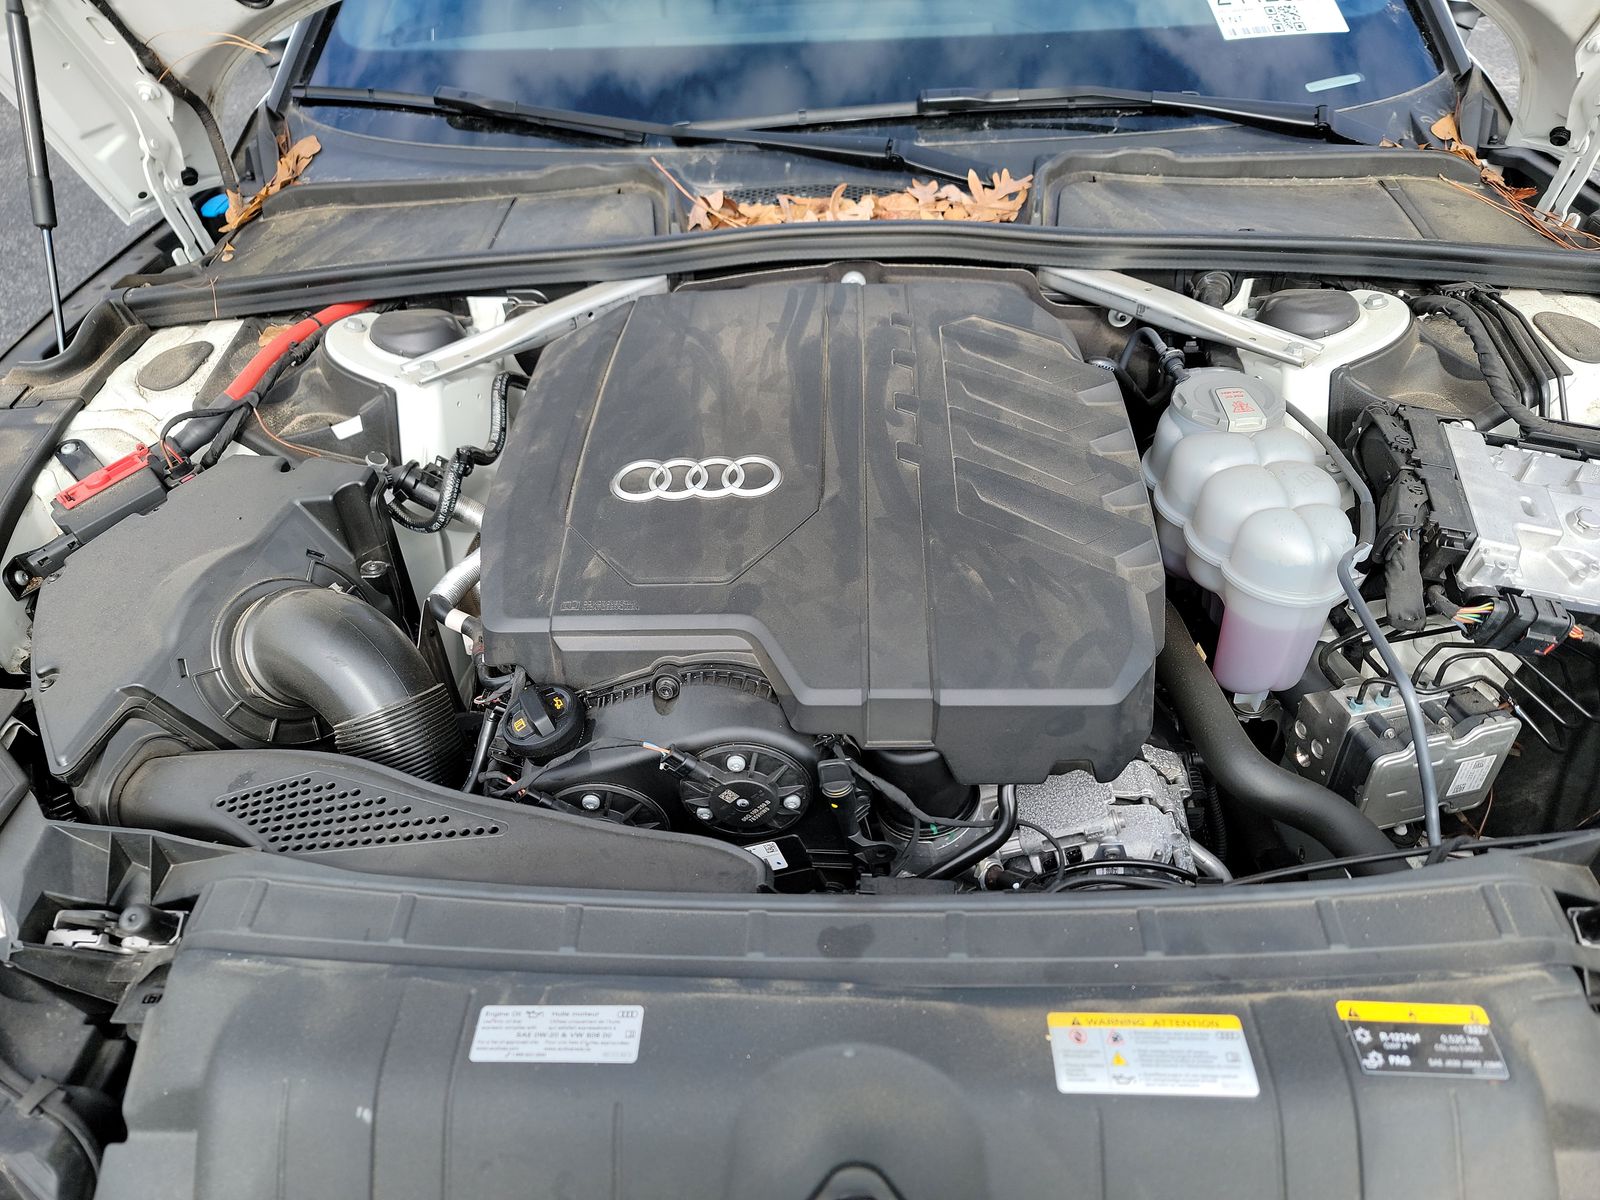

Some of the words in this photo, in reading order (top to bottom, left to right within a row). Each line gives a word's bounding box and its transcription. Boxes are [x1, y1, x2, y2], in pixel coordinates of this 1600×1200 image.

[1088, 1018, 1146, 1026] WARNING
[1153, 1019, 1219, 1027] ATTENTION
[1388, 1054, 1411, 1066] PAG
